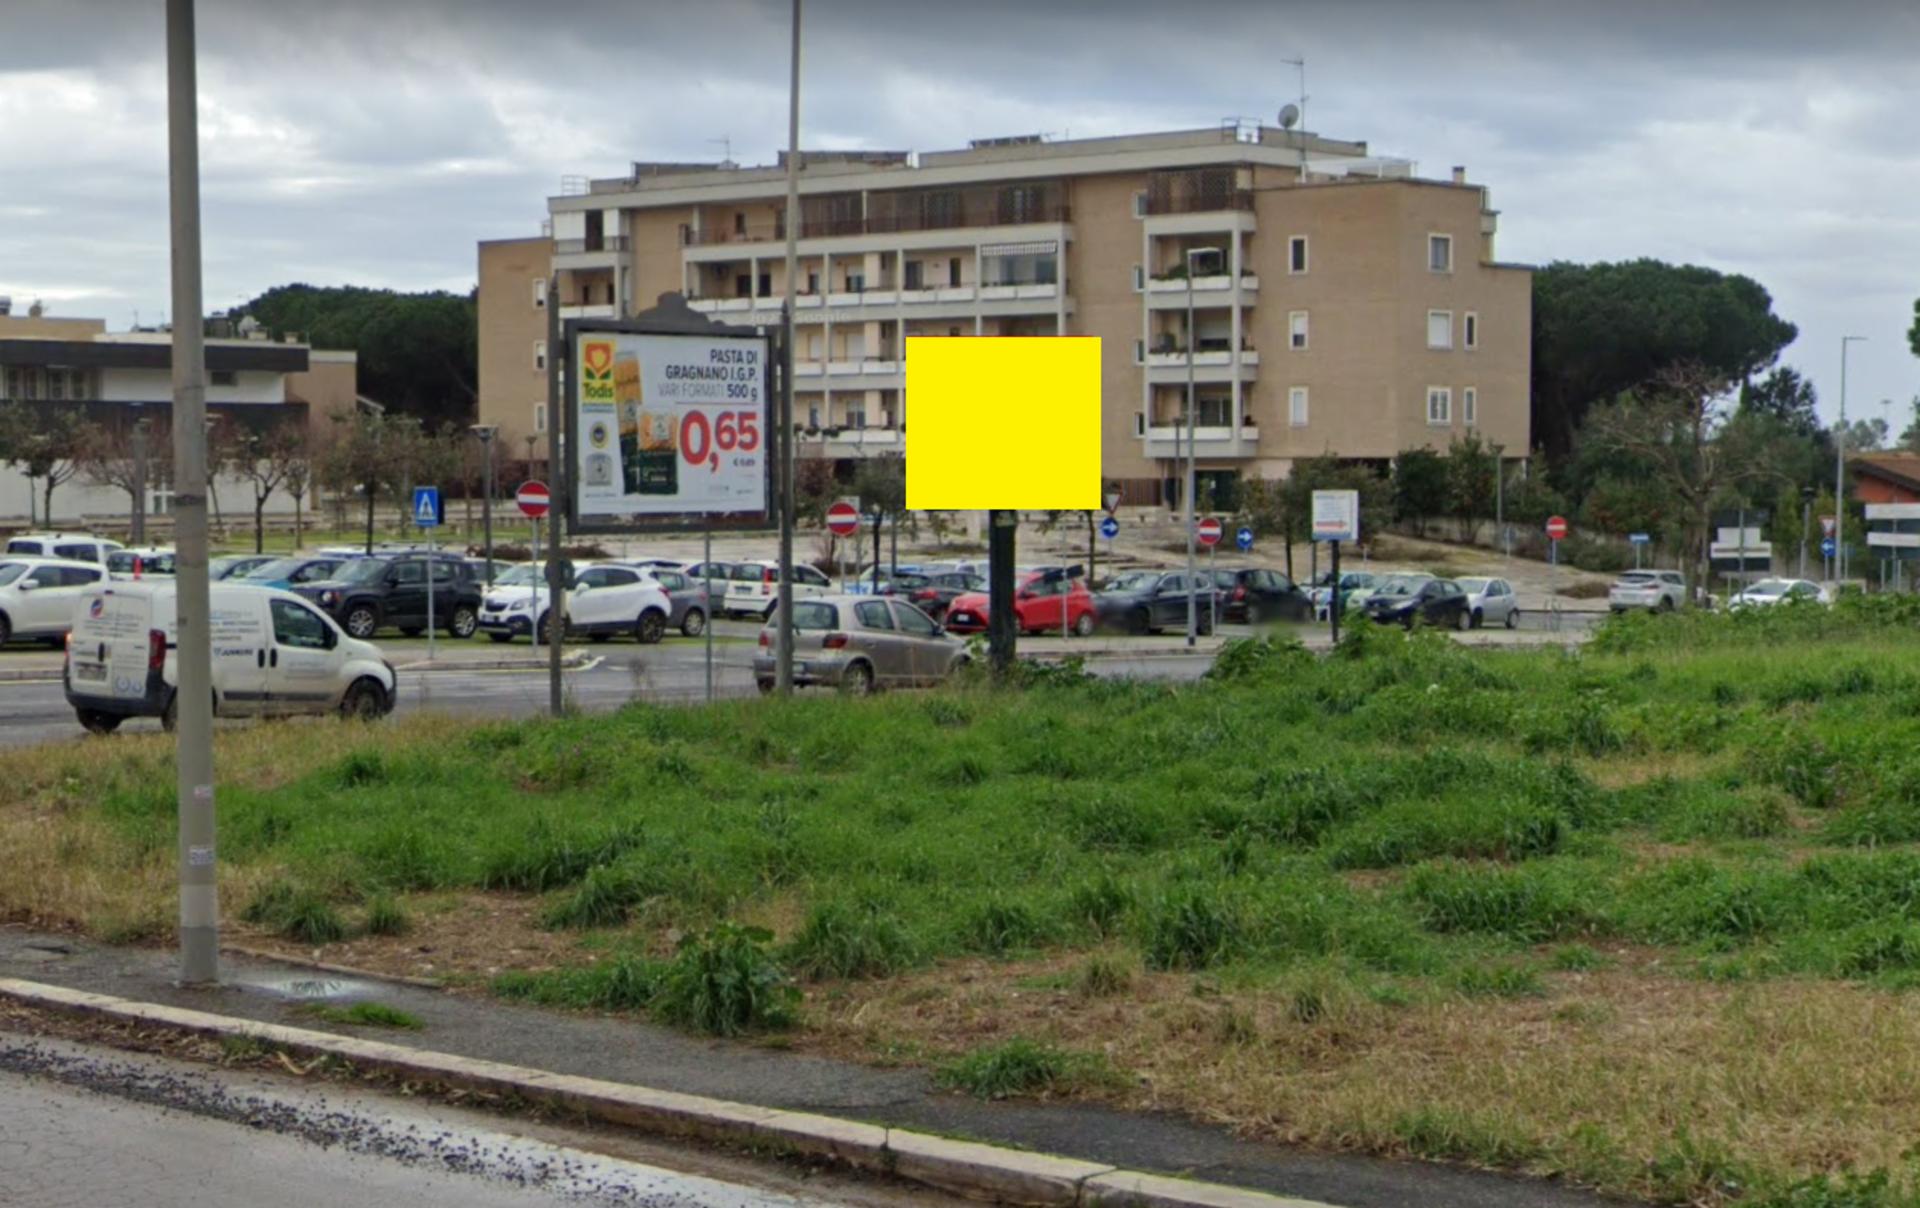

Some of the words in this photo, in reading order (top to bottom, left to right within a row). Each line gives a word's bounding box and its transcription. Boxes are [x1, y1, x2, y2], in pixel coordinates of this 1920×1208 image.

[710, 349, 743, 364] PASTA
[746, 351, 757, 364] DI
[666, 365, 728, 380] GRAGNANO
[730, 367, 758, 381] I.G.P.
[583, 382, 614, 398] Todis
[658, 382, 680, 397] VARI
[682, 384, 724, 397] FORMATI
[727, 384, 749, 398] 500
[680, 409, 759, 473] 0,65
